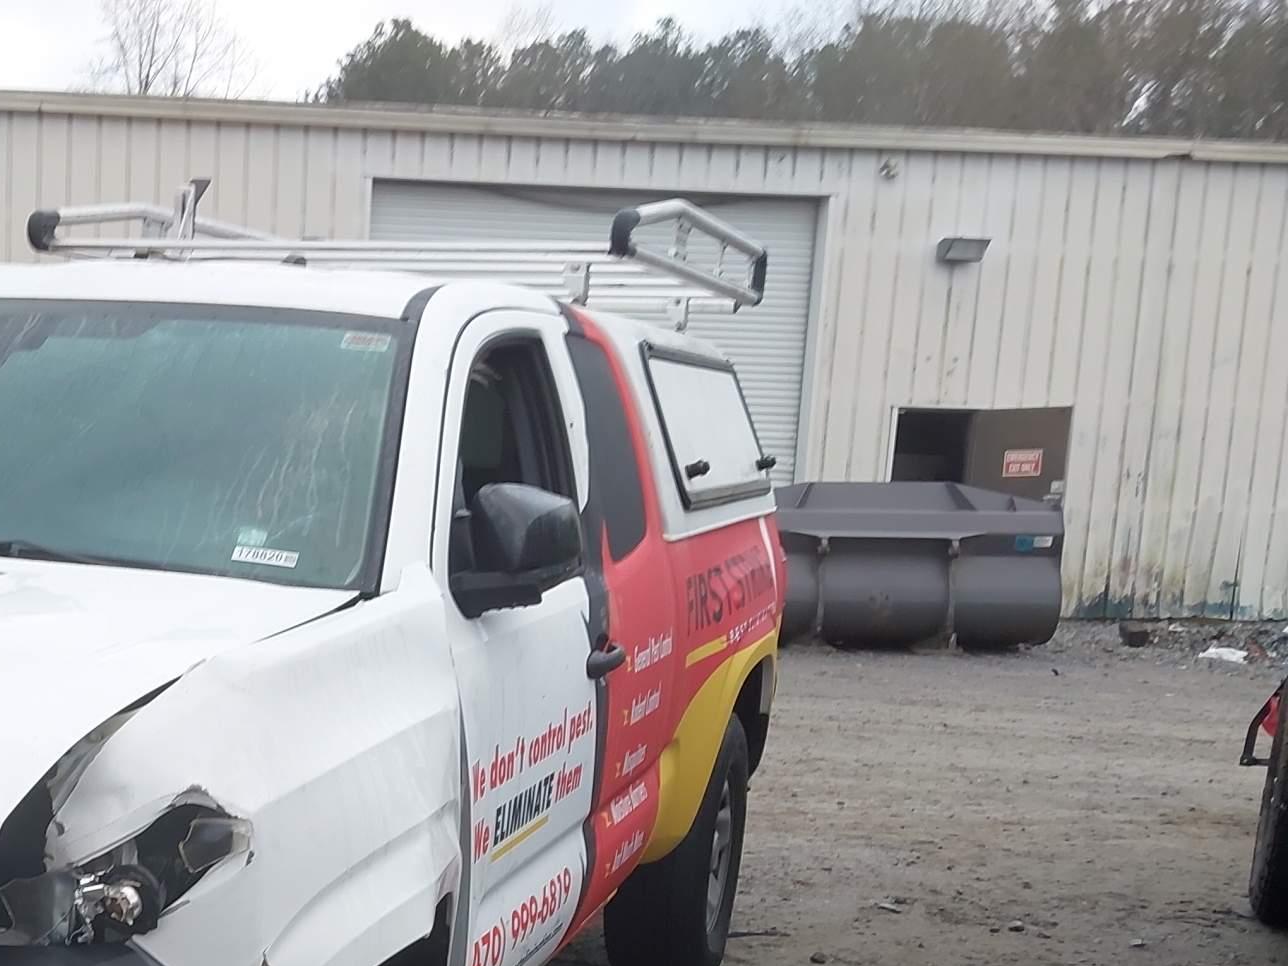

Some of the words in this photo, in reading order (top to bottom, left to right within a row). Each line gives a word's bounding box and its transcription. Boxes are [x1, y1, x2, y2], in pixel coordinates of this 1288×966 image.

[686, 563, 732, 637] FIRST
[489, 735, 525, 790] don't
[528, 706, 568, 768] control
[473, 817, 490, 865] We
[492, 771, 555, 848] ELIMINATE
[554, 761, 583, 804] them
[511, 866, 572, 950] 999-6819
